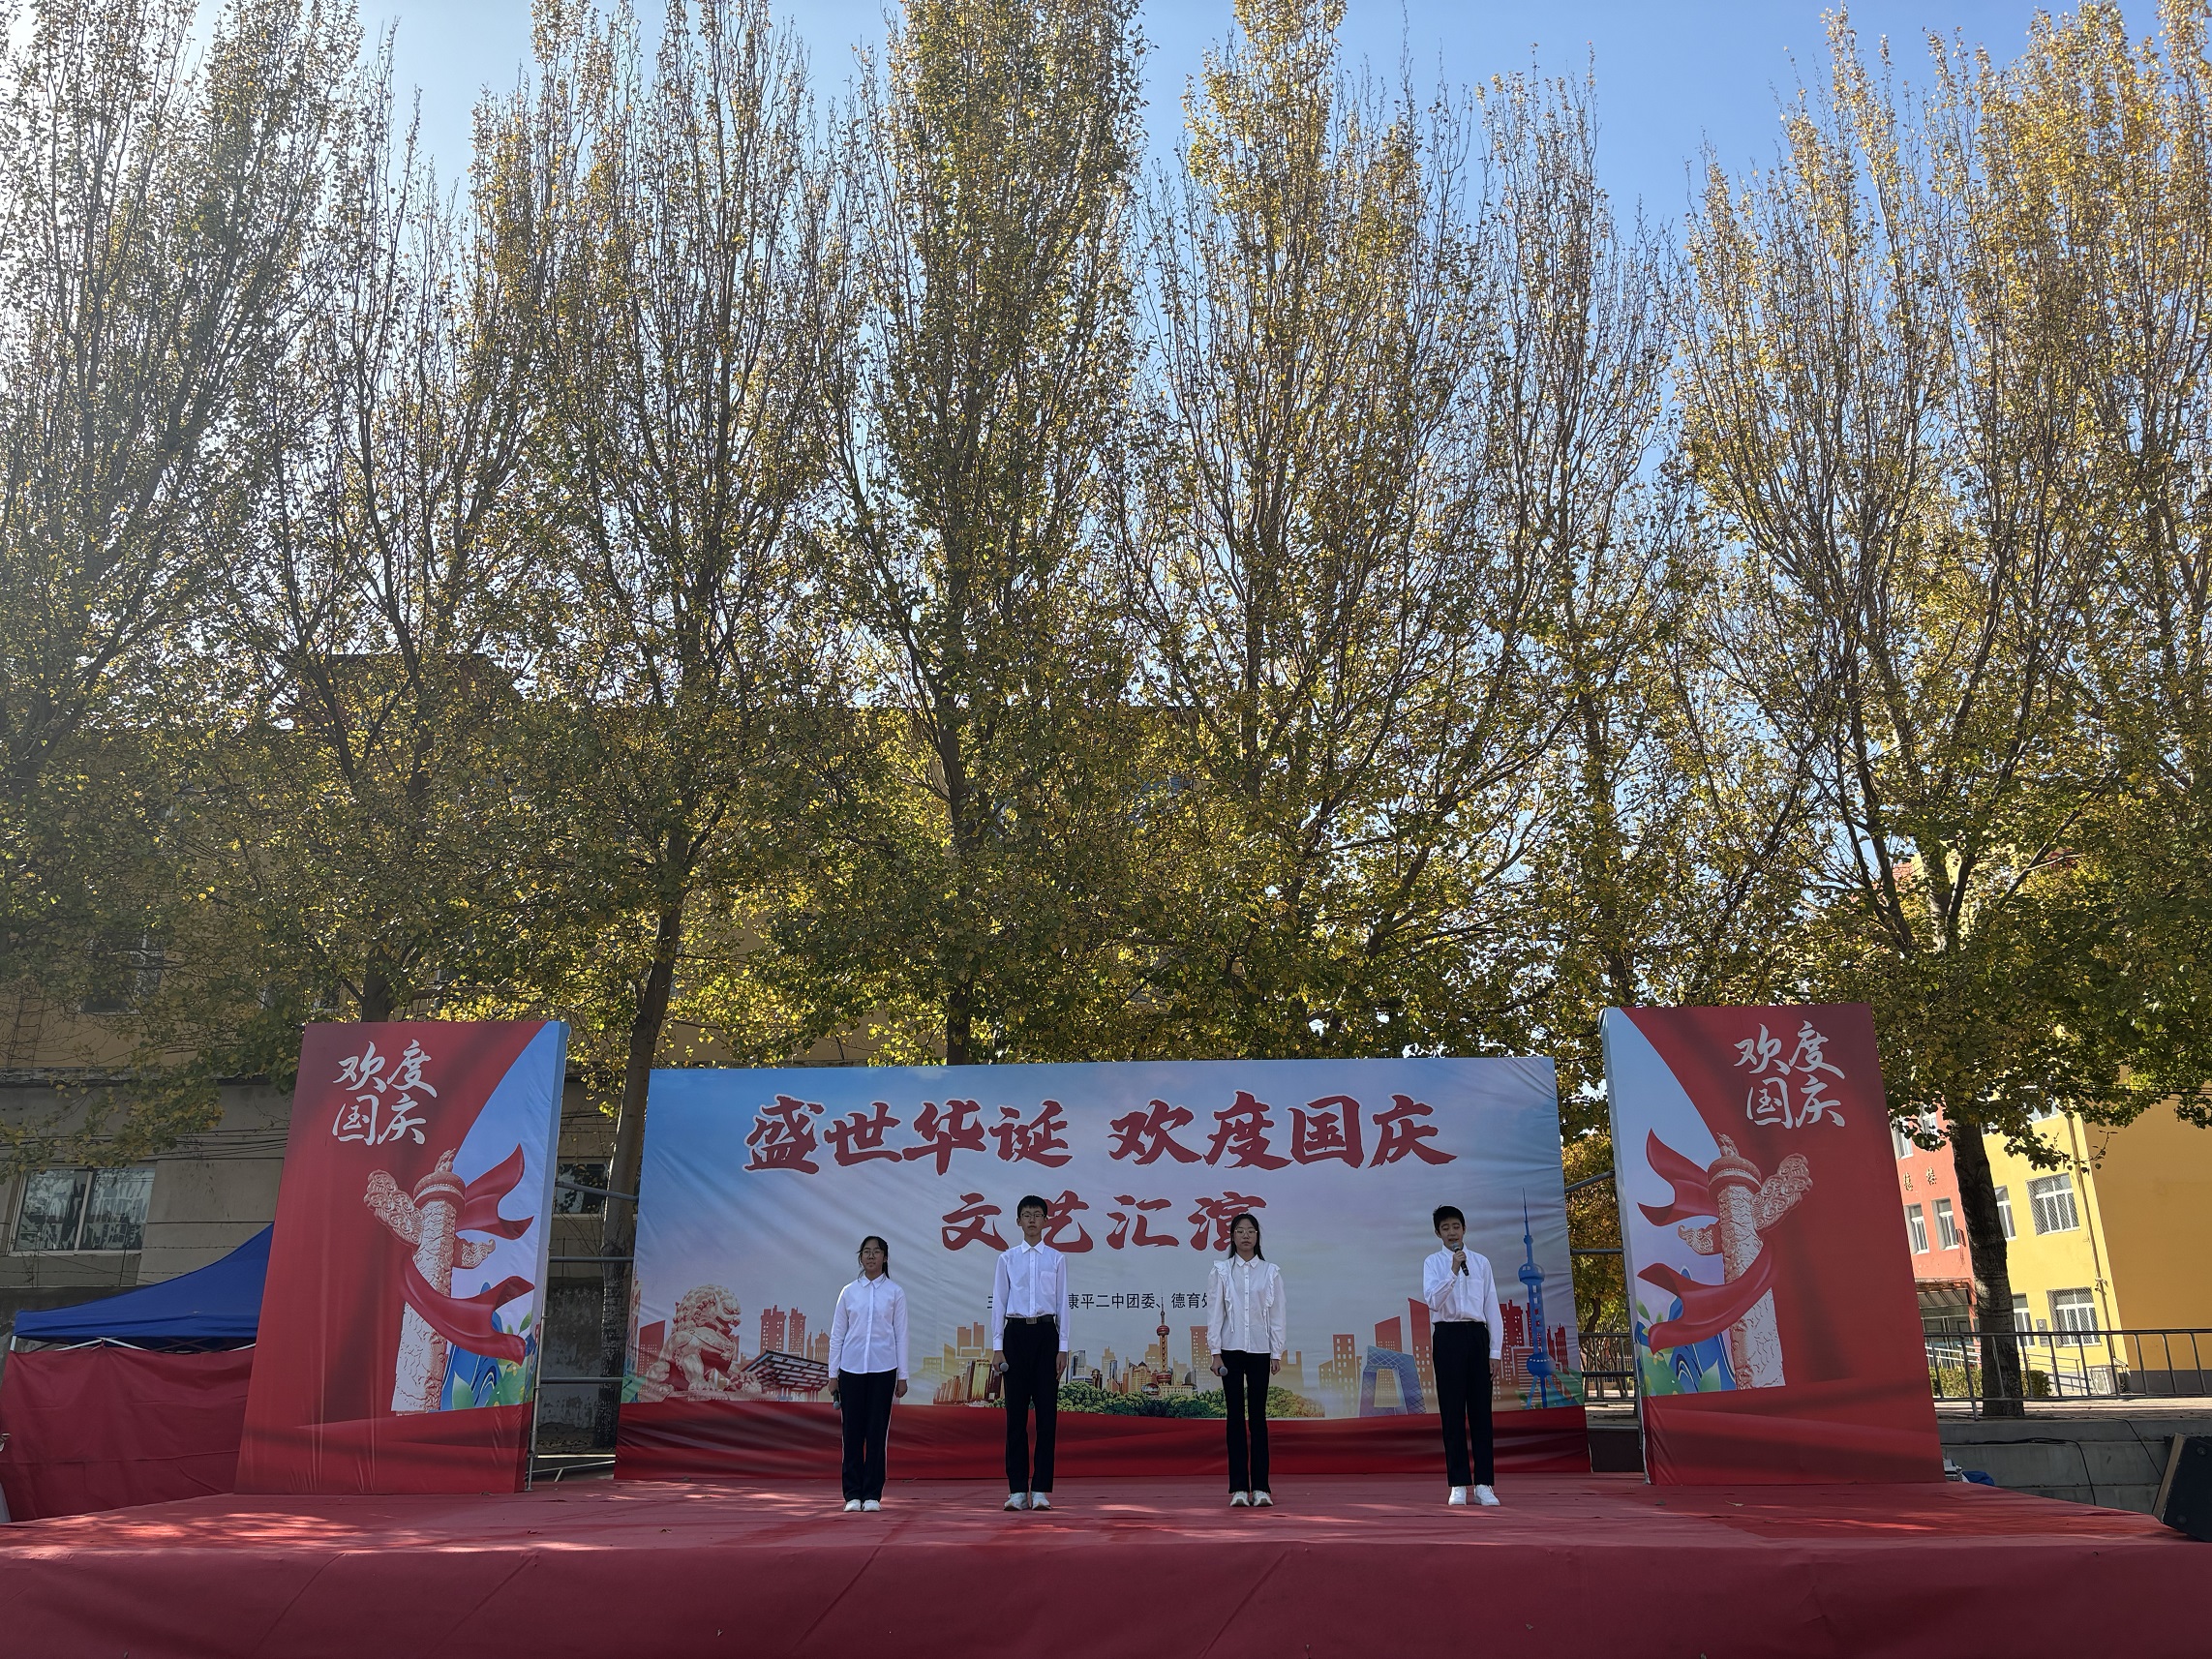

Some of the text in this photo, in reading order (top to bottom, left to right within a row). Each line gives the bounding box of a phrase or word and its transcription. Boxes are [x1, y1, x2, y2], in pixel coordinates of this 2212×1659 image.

[332, 1039, 438, 1099] 欢度
[1733, 1019, 1846, 1080] 欢度
[331, 1092, 427, 1146] 国庆
[1745, 1073, 1846, 1130] 国庆
[744, 1090, 1458, 1175] 盛世华诞 欢度国庆
